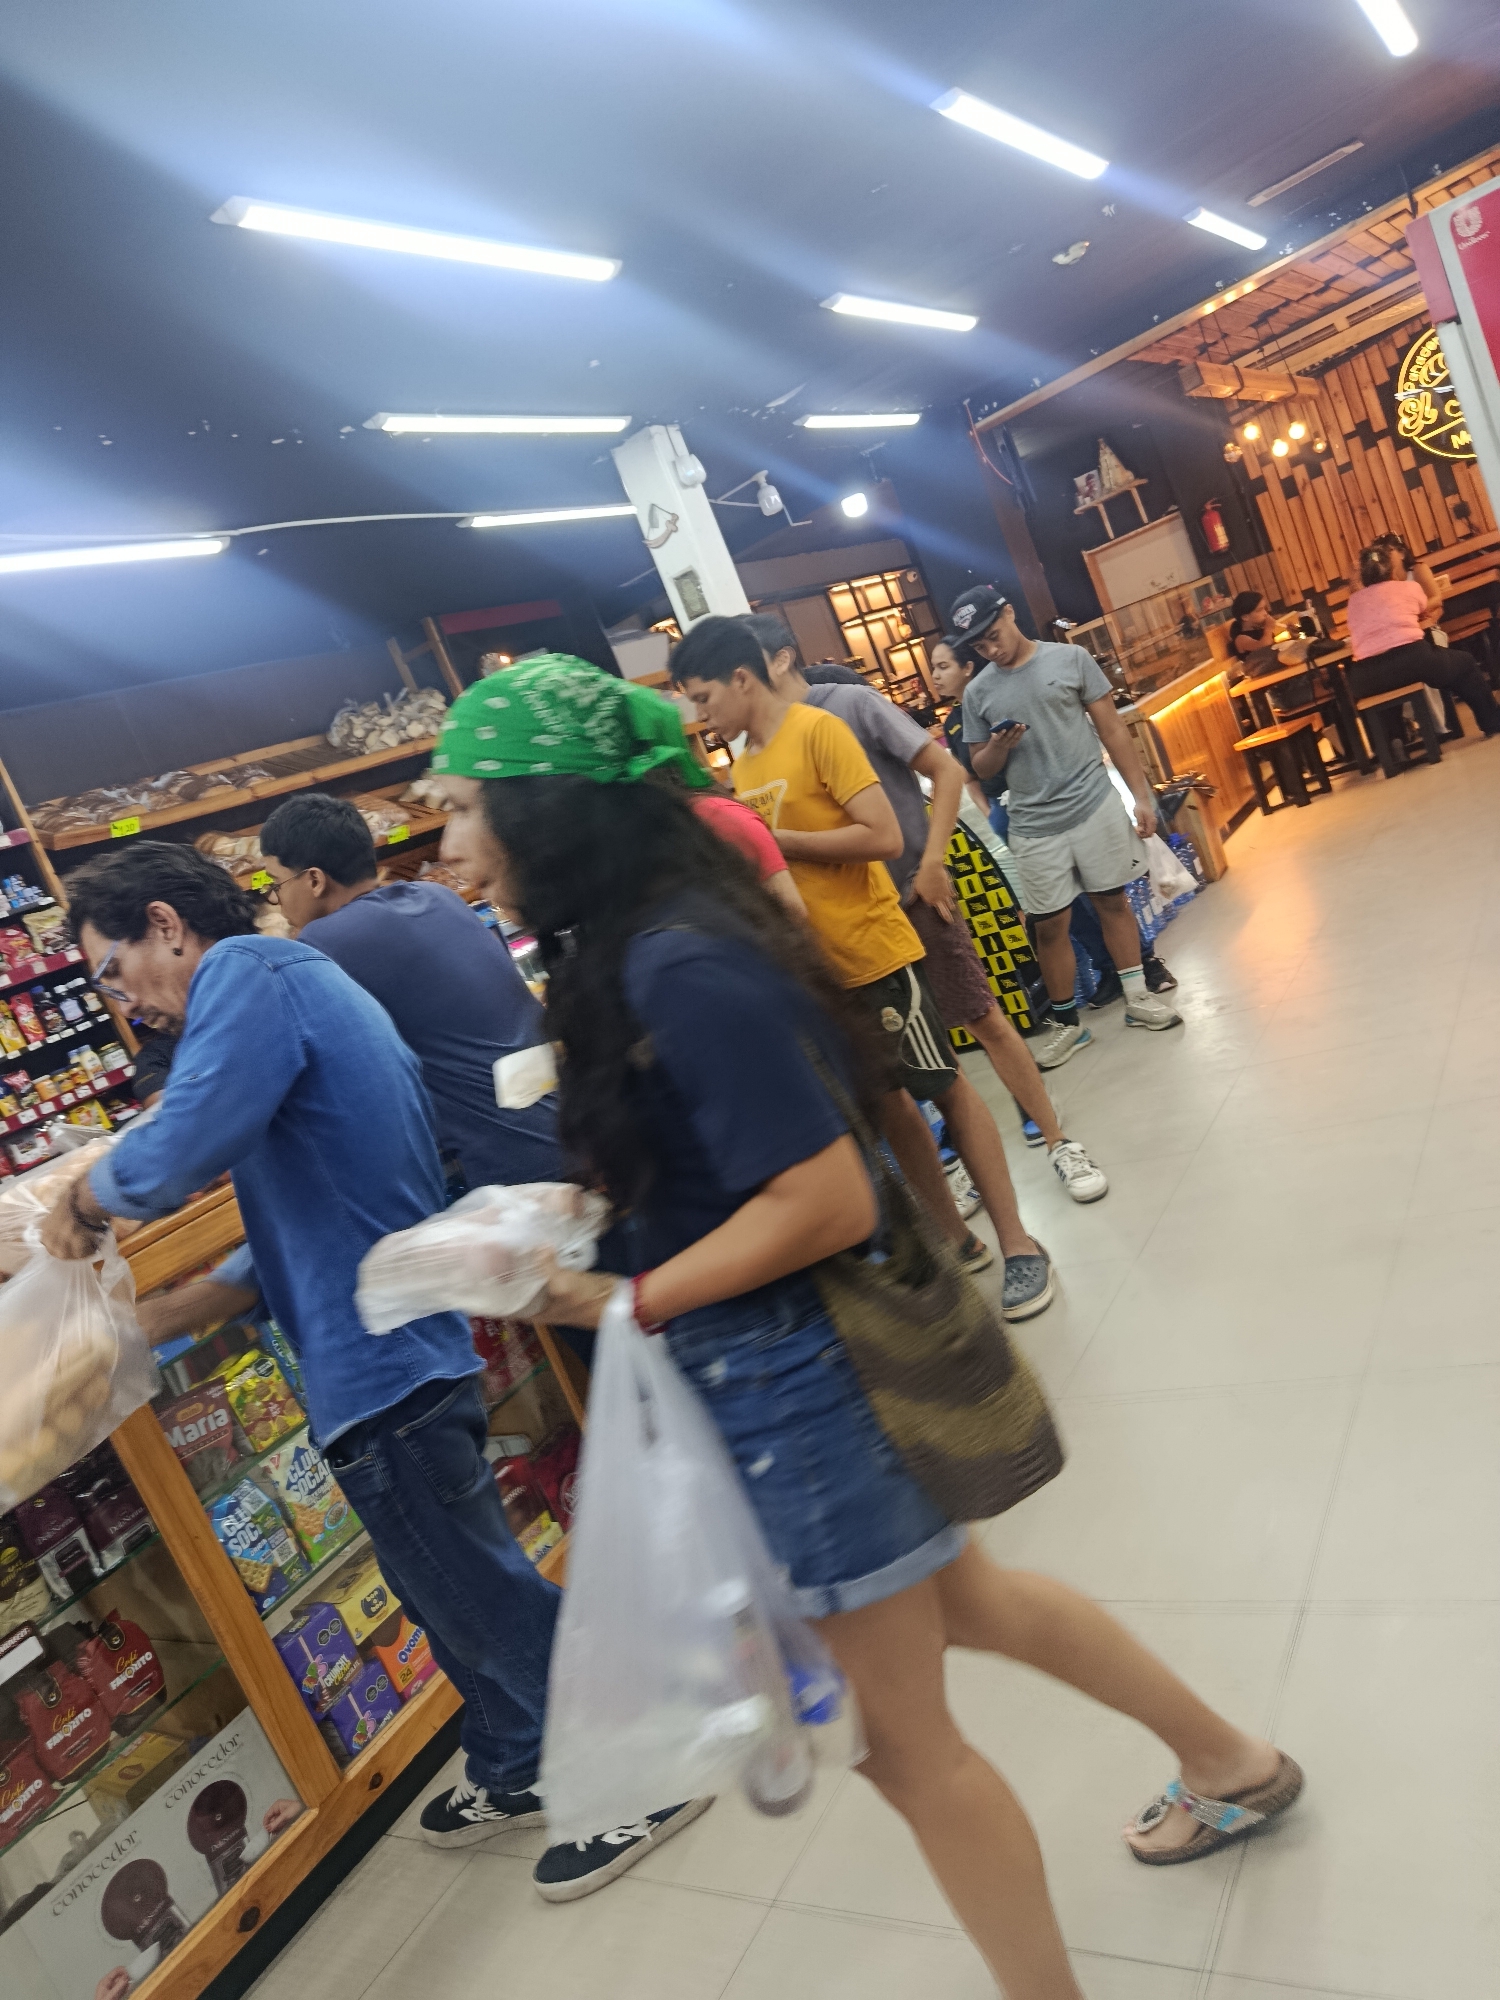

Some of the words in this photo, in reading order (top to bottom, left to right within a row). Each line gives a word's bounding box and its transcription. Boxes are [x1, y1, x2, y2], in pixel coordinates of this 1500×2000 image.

[323, 1653, 351, 1688] CRUNCHY
[400, 1668, 413, 1685] 24
[165, 1733, 240, 1809] conocedor
[52, 1830, 139, 1917] conocedor
